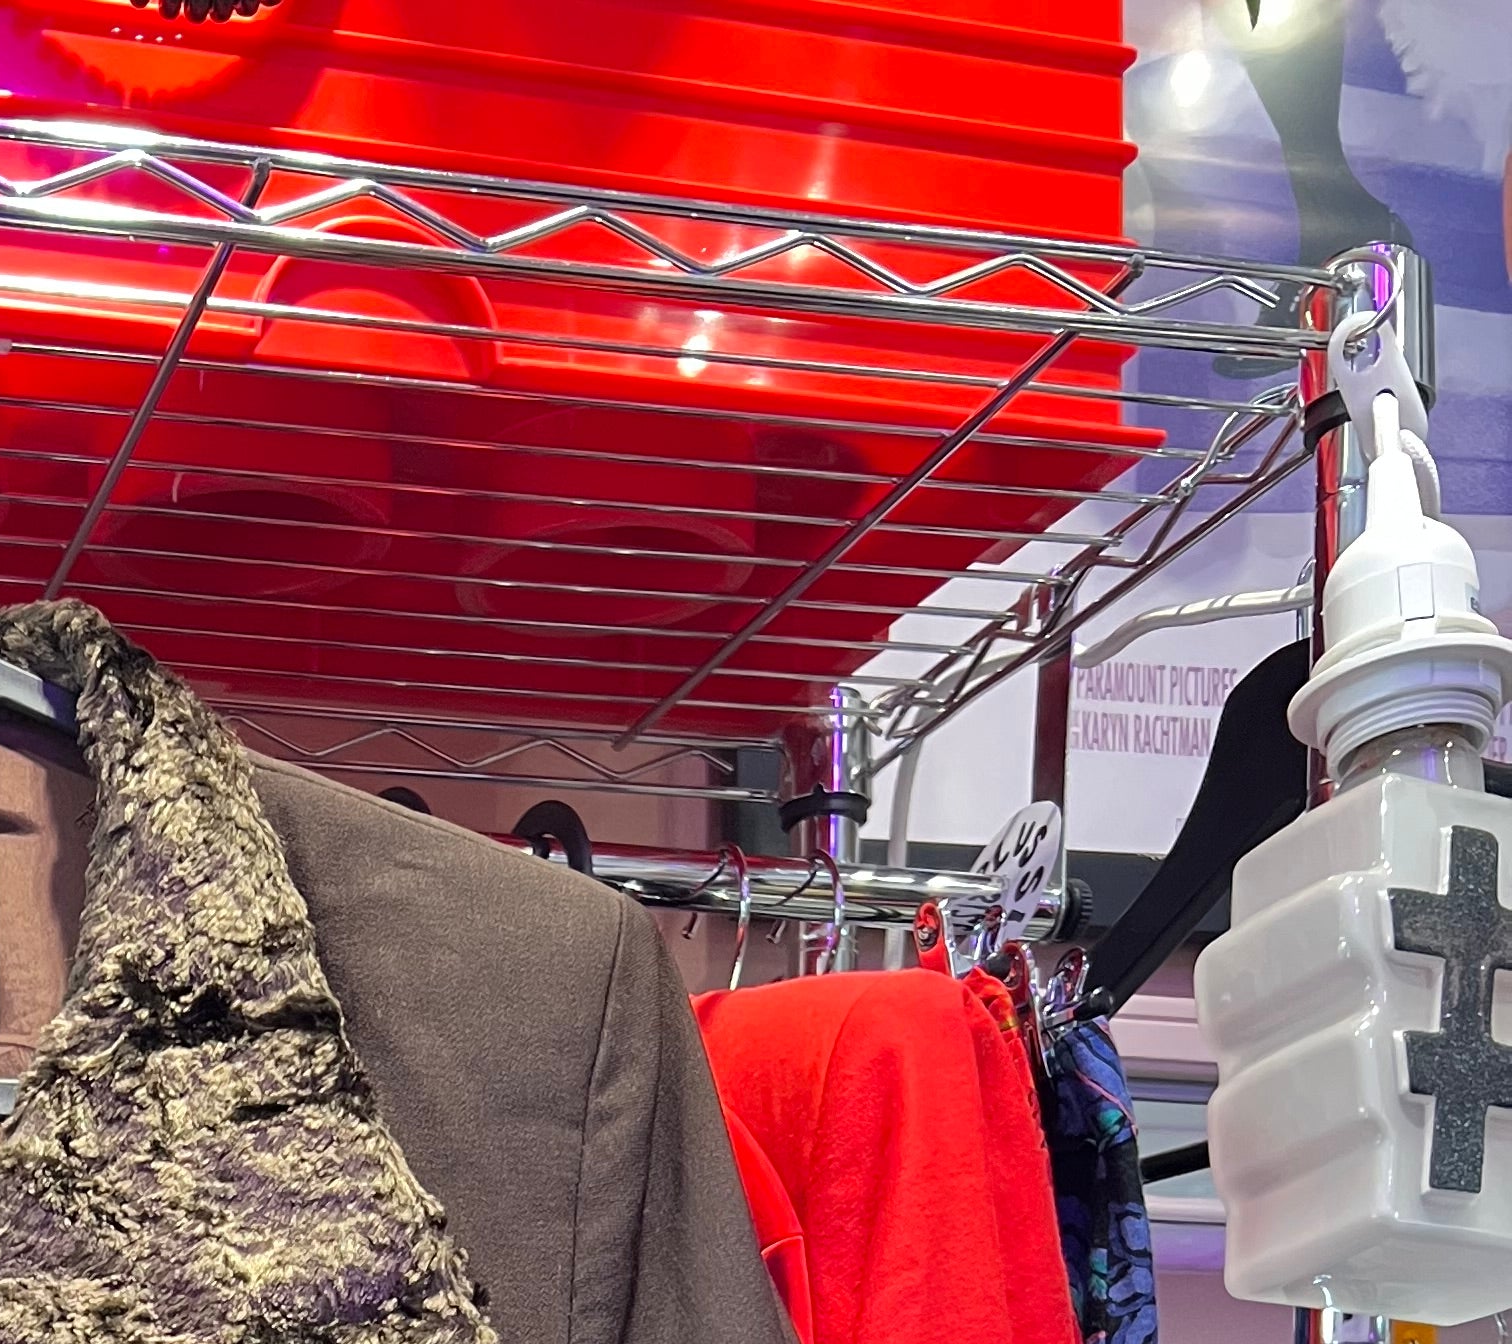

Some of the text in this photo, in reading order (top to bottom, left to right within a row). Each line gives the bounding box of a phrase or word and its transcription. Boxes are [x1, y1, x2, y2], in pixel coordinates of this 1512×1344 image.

[1076, 662, 1166, 704] PARAMOUNT
[1081, 710, 1129, 752] KARYN
[1133, 714, 1212, 757] RACHTMAN
